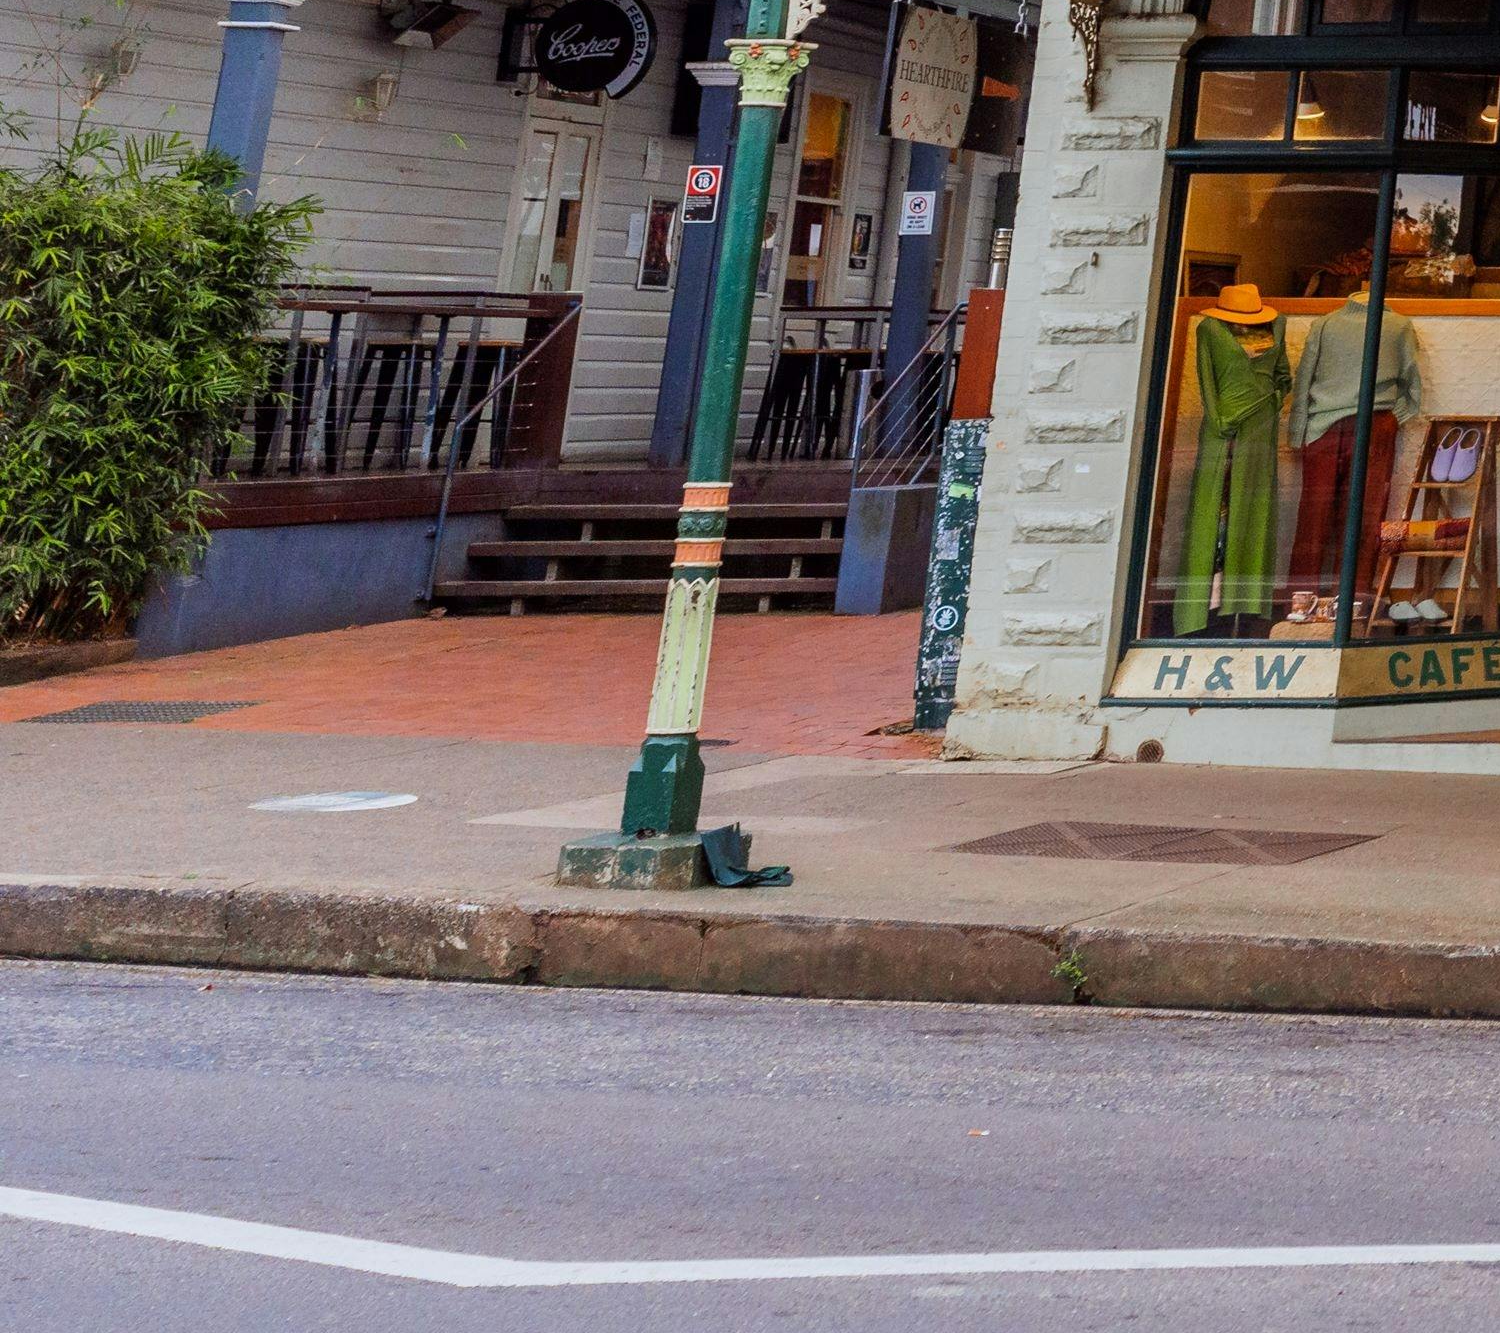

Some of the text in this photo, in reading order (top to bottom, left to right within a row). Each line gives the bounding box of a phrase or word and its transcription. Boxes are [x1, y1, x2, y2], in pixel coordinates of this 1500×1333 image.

[626, 5, 647, 67] FEDERAL
[899, 59, 970, 94] HEARTHFIRE
[697, 177, 710, 188] 18
[1153, 654, 1306, 690] H & W
